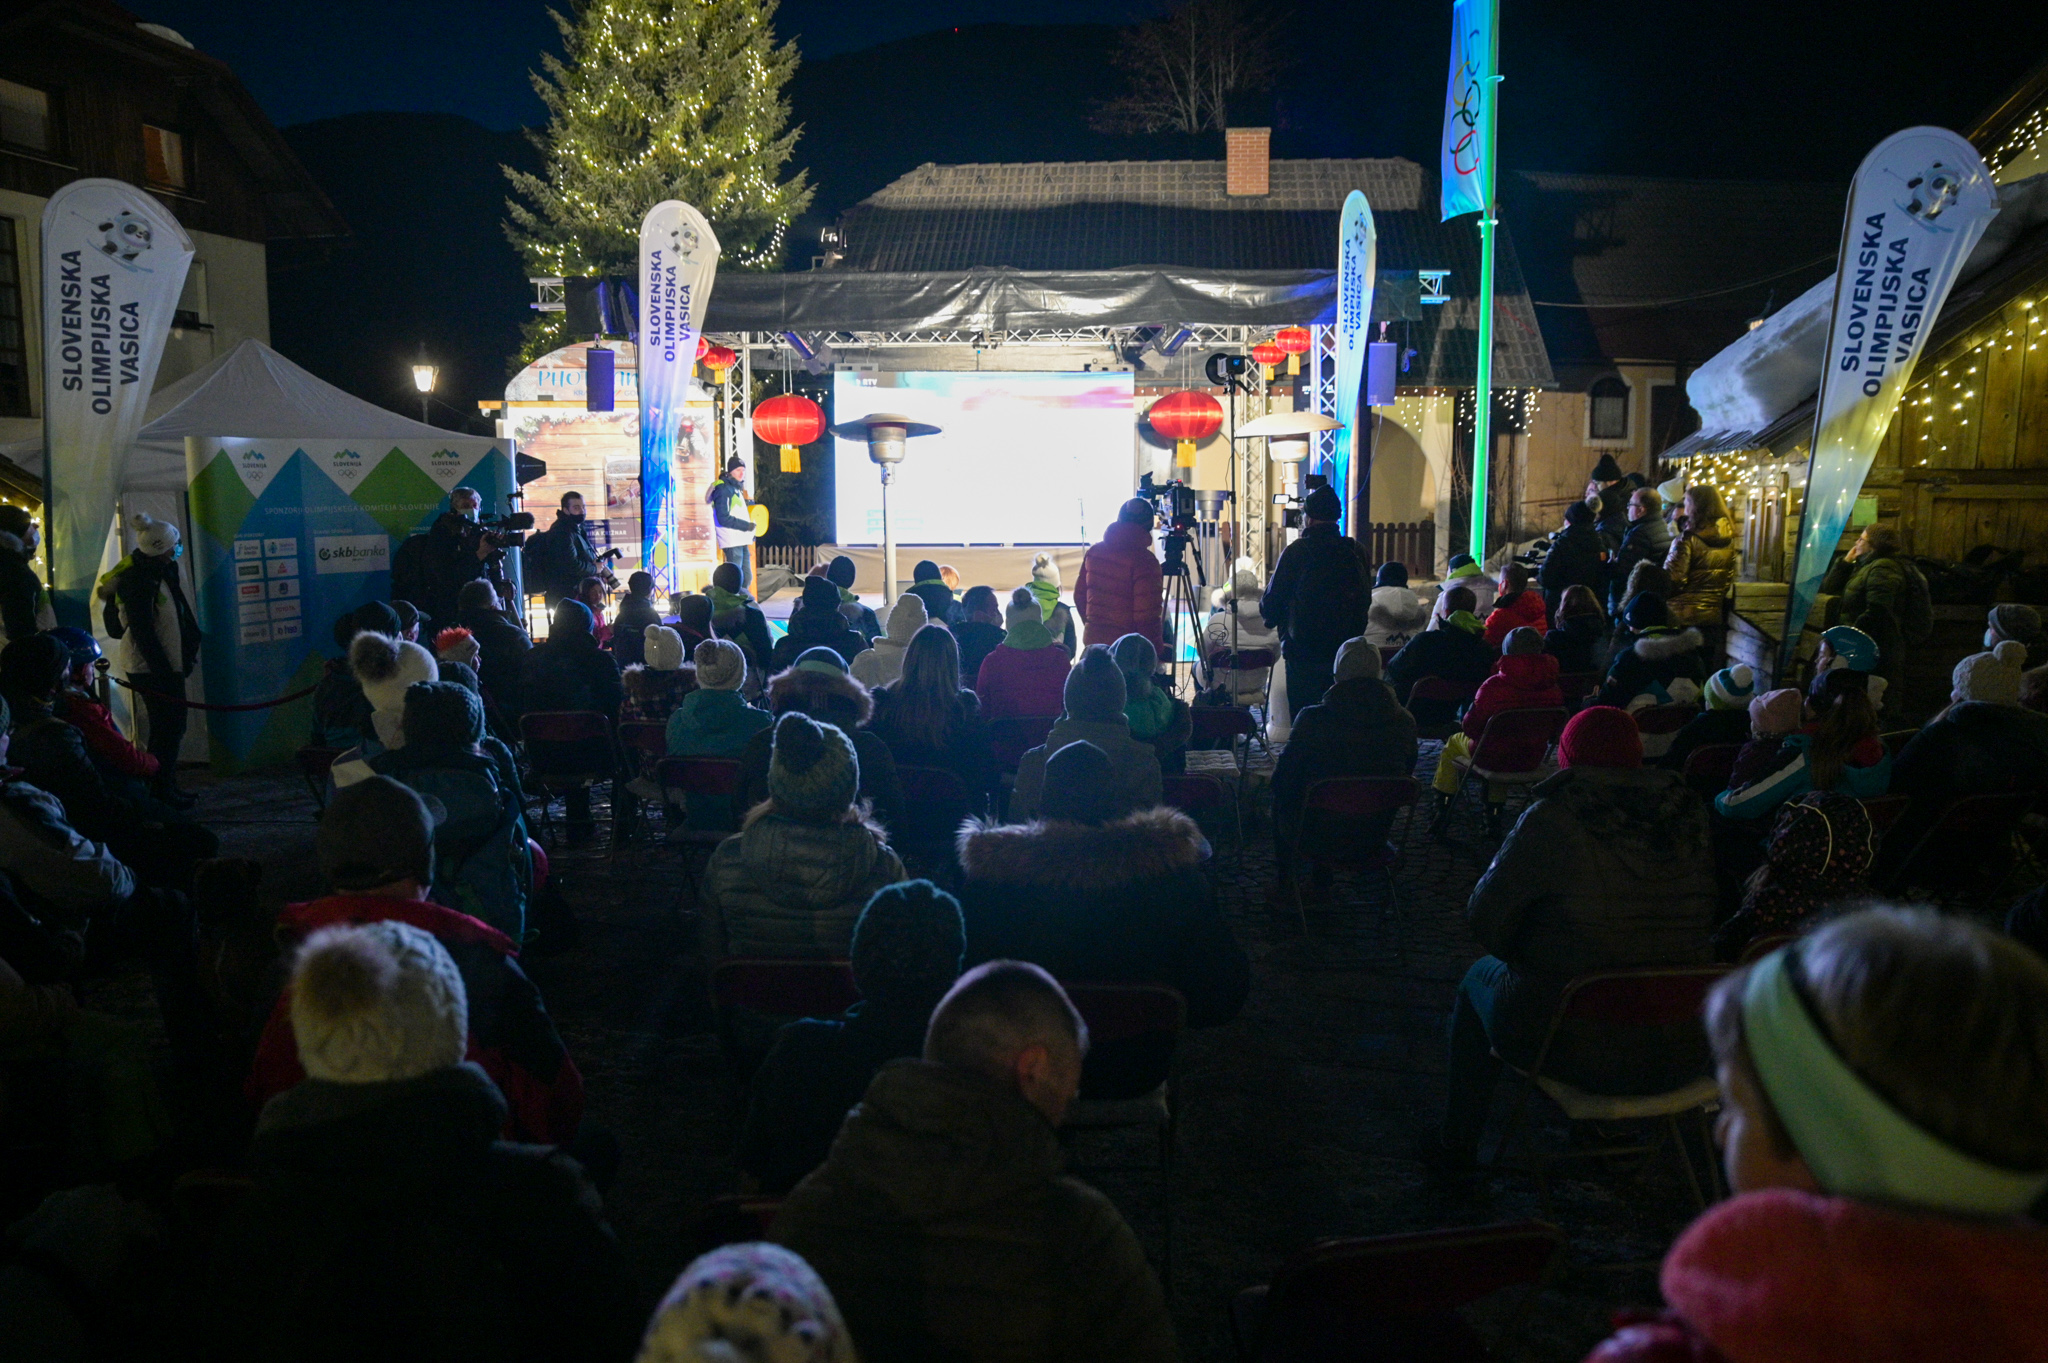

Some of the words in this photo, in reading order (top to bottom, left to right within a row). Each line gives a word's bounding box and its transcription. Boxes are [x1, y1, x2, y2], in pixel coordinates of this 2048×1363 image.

[61, 250, 82, 391] SLOVENSKA
[650, 250, 662, 346] SLOVENSKA
[664, 266, 677, 362] OLIMPIJSKA
[679, 284, 691, 341] VASICA
[1342, 239, 1351, 334] SLOVENSKA
[1348, 255, 1357, 350] OLIMPIJSKA
[1841, 212, 1886, 372] SLOVENSKA
[1863, 237, 1909, 397] OLIMPIJSKA
[1894, 267, 1931, 363] VASICA
[91, 274, 112, 415] OLIMPIJSKA
[119, 302, 139, 385] VASICA
[359, 504, 397, 512] KOMITEJA
[399, 503, 440, 511] SLOVENIJE
